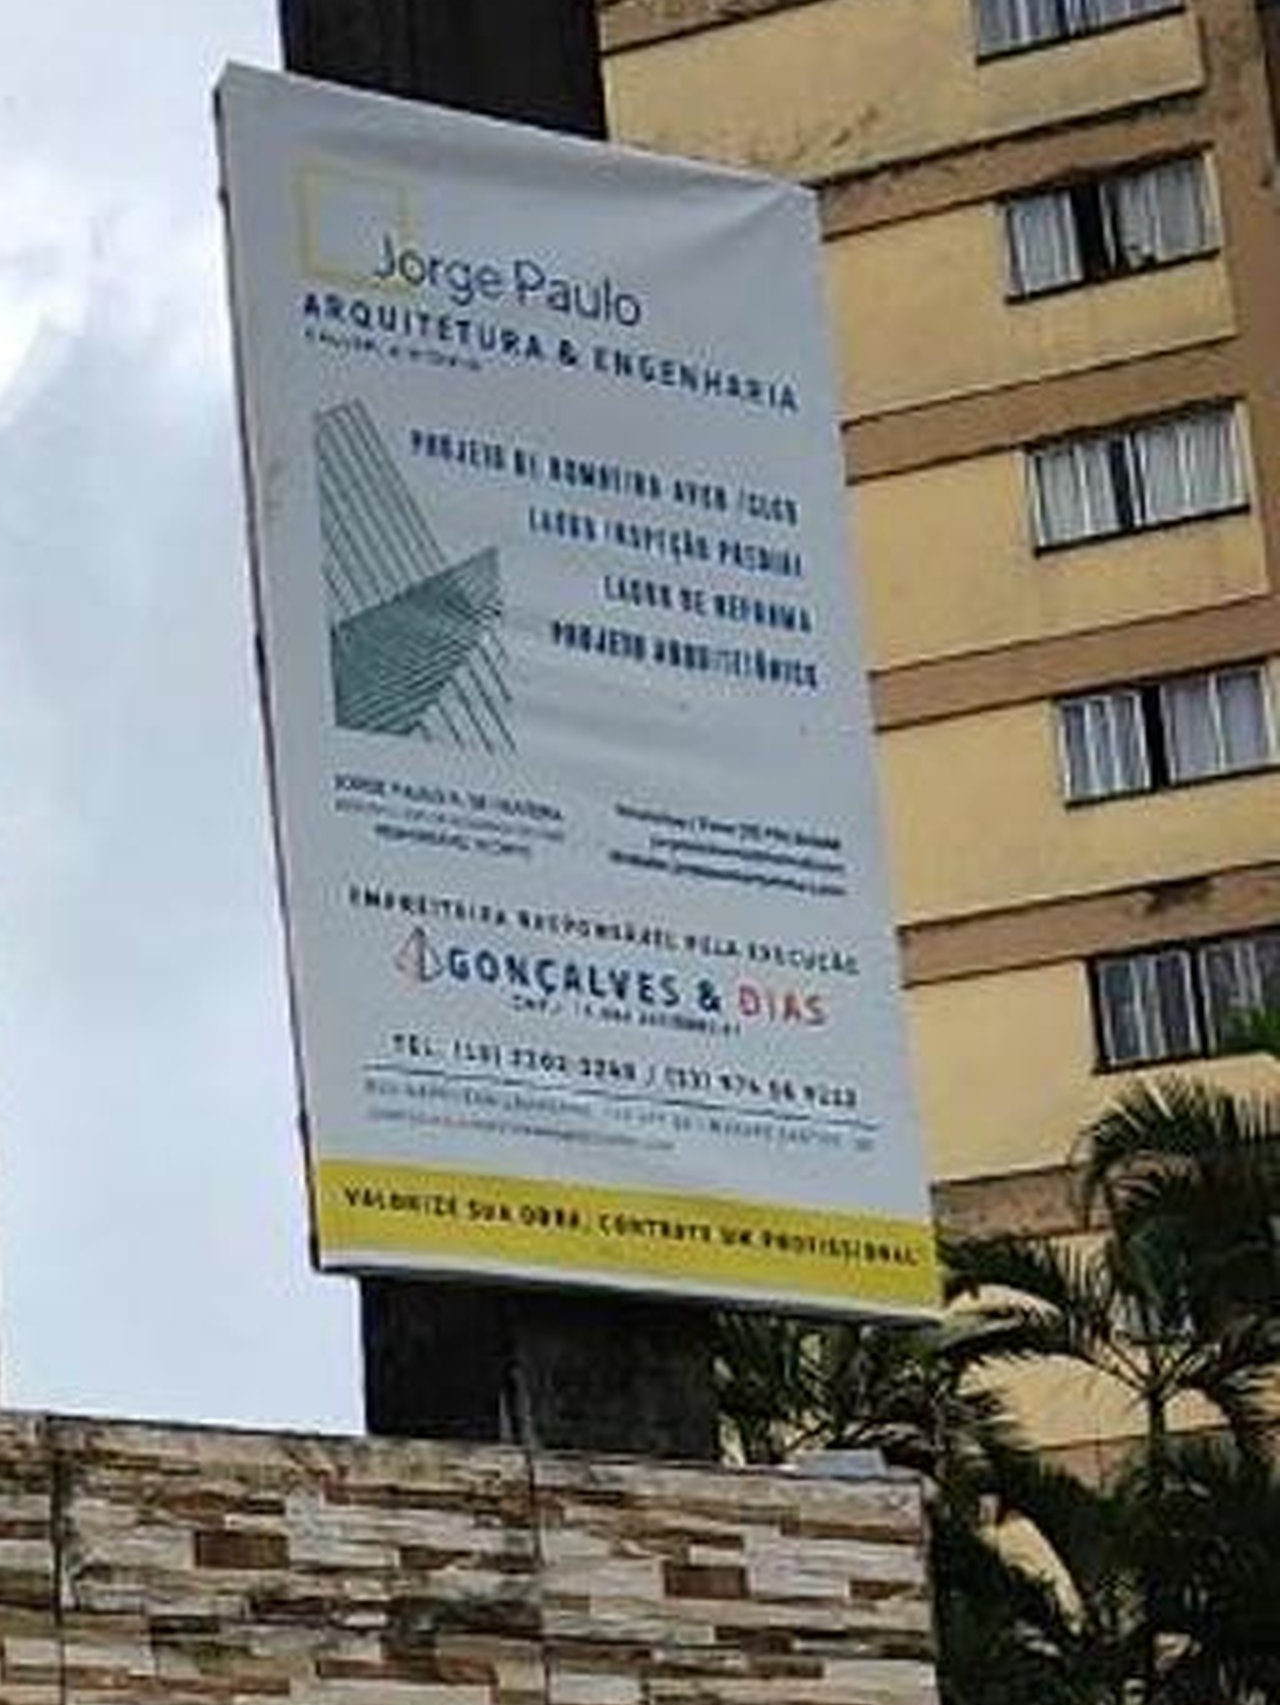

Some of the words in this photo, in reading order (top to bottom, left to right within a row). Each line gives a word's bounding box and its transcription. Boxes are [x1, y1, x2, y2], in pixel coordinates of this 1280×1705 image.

[373, 233, 503, 308] Jorge
[514, 260, 642, 327] Paulo
[303, 293, 545, 361] ARQUITETURA
[558, 338, 579, 368] &
[593, 348, 800, 412] ENGENHARIA
[410, 428, 506, 472] PROJETO
[679, 587, 707, 617] DE
[714, 593, 812, 634] REFORMA
[551, 618, 646, 662] PROJETO
[447, 946, 682, 1009] GONÇALVES
[697, 978, 723, 1014] &
[738, 983, 828, 1027] DIAS
[344, 1187, 457, 1217] VALORIZE
[467, 1197, 512, 1222] SUA
